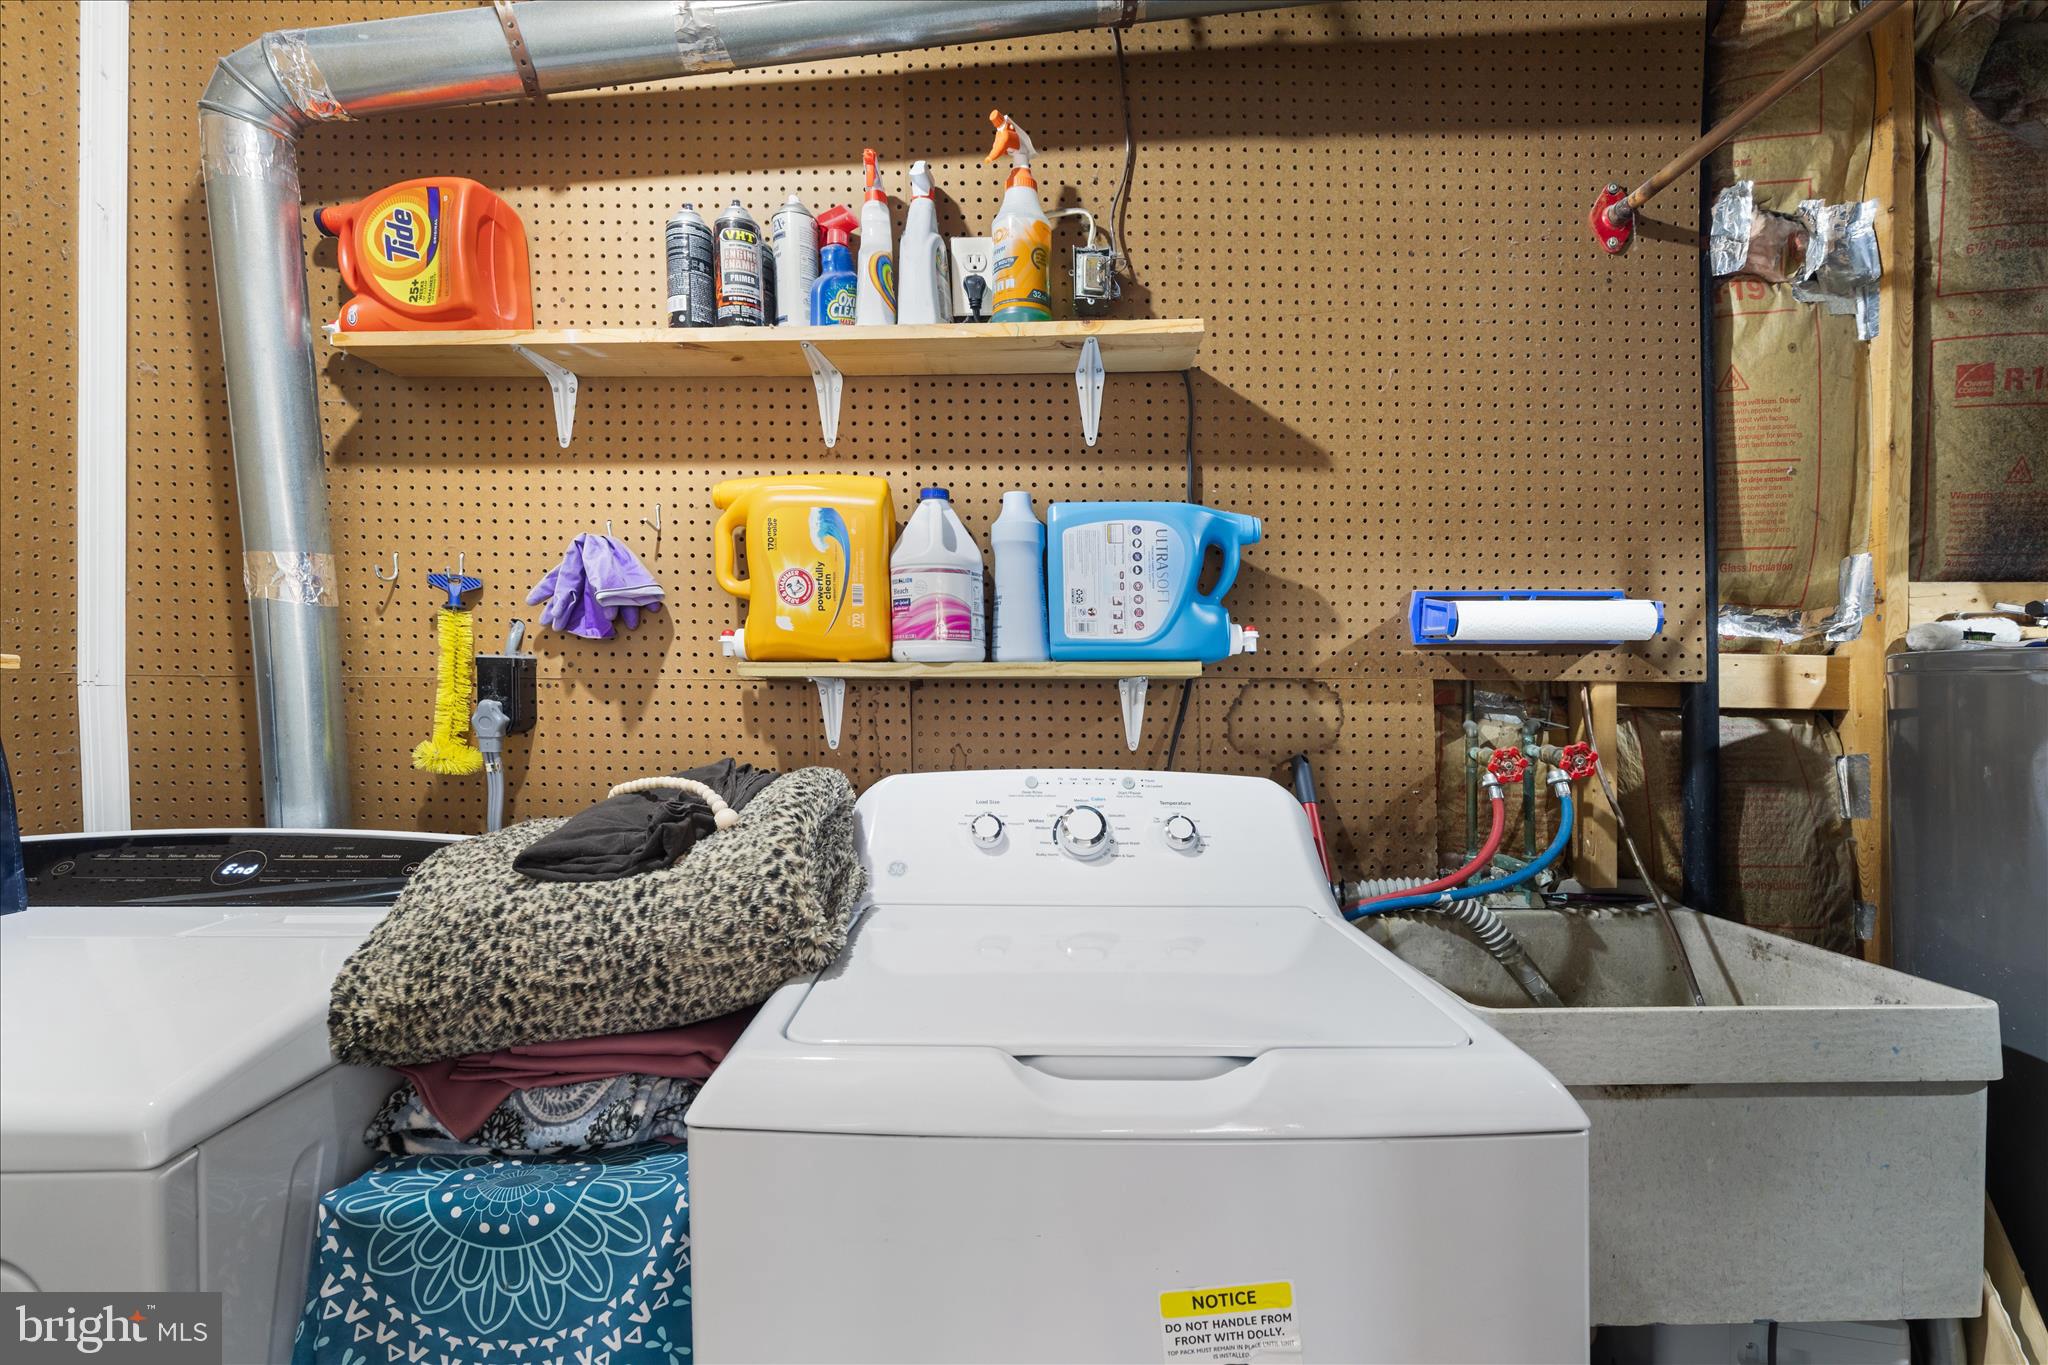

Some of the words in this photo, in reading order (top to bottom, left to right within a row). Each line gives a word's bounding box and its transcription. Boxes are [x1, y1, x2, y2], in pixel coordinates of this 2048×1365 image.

[384, 208, 421, 262] Tide
[725, 229, 755, 243] VHT
[730, 274, 756, 285] PRIMER
[409, 279, 419, 303] 25+
[1032, 290, 1042, 298] 32
[1155, 528, 1170, 605] ULTRASOFT
[1720, 563, 1746, 573] Glass
[1749, 562, 1793, 573] Insulation
[779, 569, 800, 592] HAMMER
[818, 561, 826, 612] powerfully
[851, 613, 860, 628] 170
[221, 863, 259, 875] End
[1192, 1290, 1257, 1310] NOTICE
[1165, 1323, 1182, 1334] DO
[1185, 1320, 1209, 1332] NOT
[1212, 1316, 1258, 1329] HANDLE
[1261, 1312, 1292, 1325] FROM
[1174, 1333, 1212, 1346] FRONT
[1214, 1330, 1245, 1342] WITH
[1247, 1327, 1285, 1340] DOLLY.
[1180, 1348, 1196, 1356] PACK
[1244, 1342, 1261, 1350] PLACE
